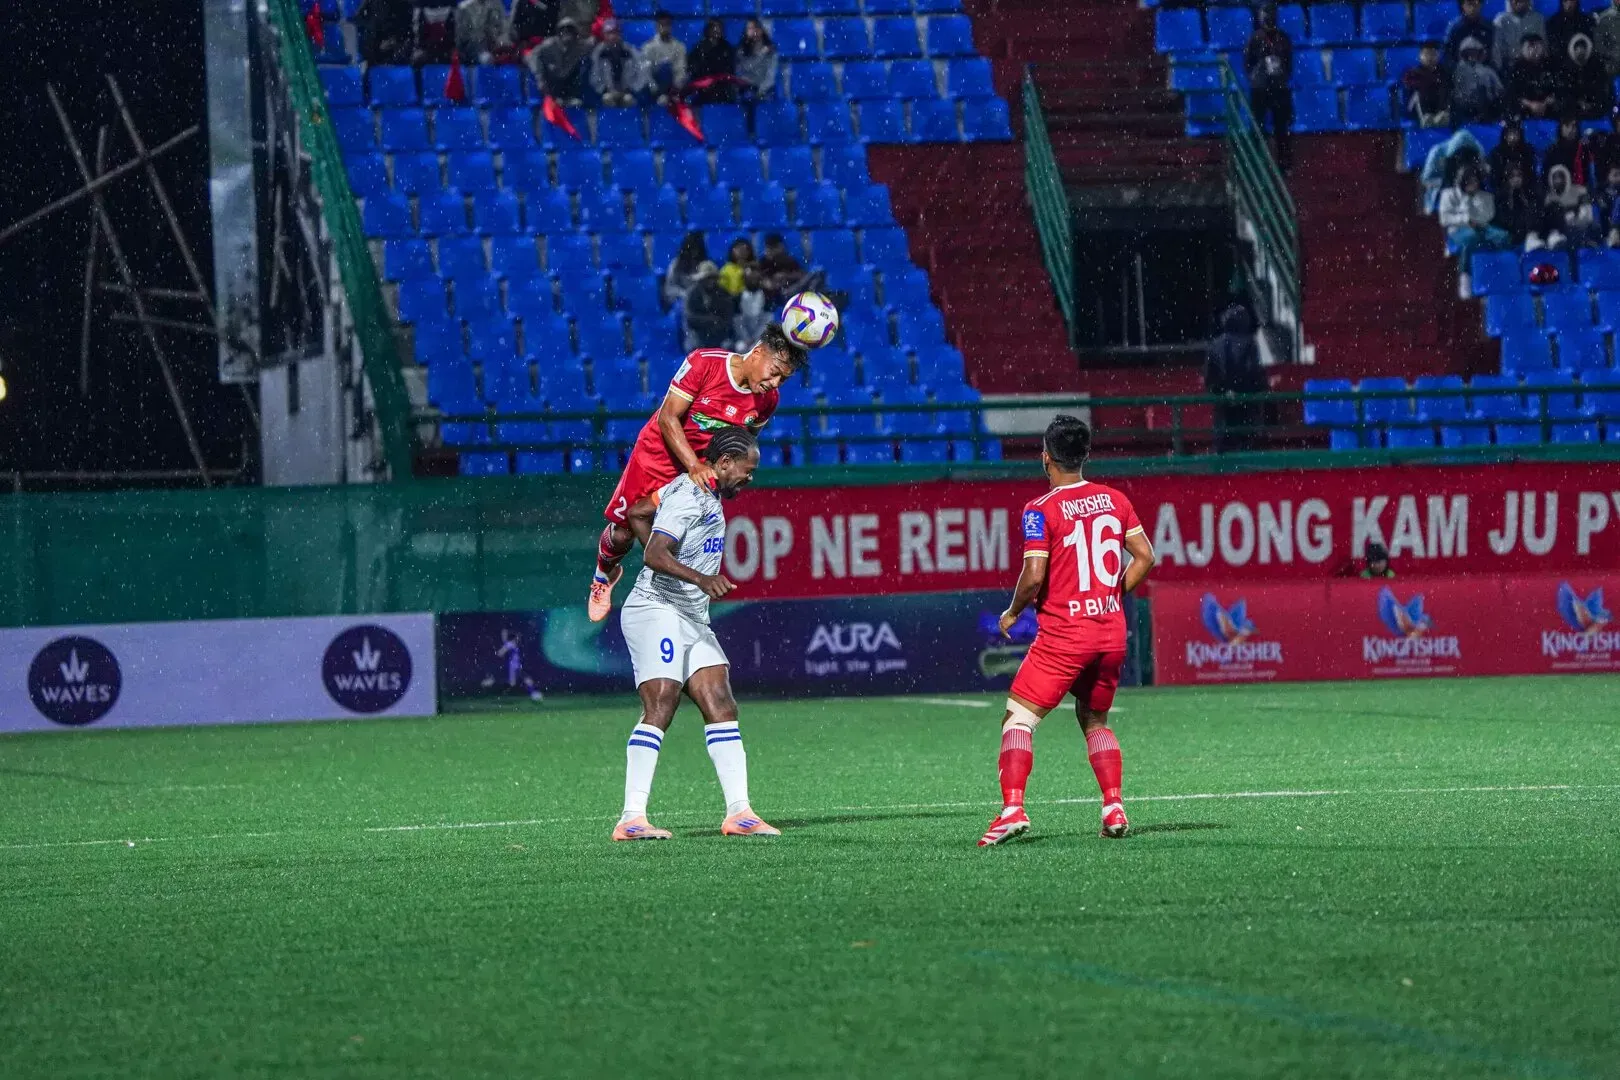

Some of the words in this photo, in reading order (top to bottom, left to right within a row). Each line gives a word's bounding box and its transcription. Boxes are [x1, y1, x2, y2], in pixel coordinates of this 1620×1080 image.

[613, 496, 628, 520] 2
[1058, 493, 1116, 520] KINGFISHER
[811, 514, 883, 579] NE
[899, 508, 1010, 574] REM
[1121, 499, 1334, 567] AJONG
[1352, 495, 1469, 560] KAM
[1488, 490, 1559, 555] JU
[1063, 513, 1122, 592] 16
[660, 638, 674, 663] 9
[804, 622, 901, 654] AURA
[1363, 635, 1461, 663] KINGFISHER
[1186, 640, 1283, 668] KINGFISHER
[41, 684, 110, 703] WAVES
[334, 671, 402, 692] WAVES
